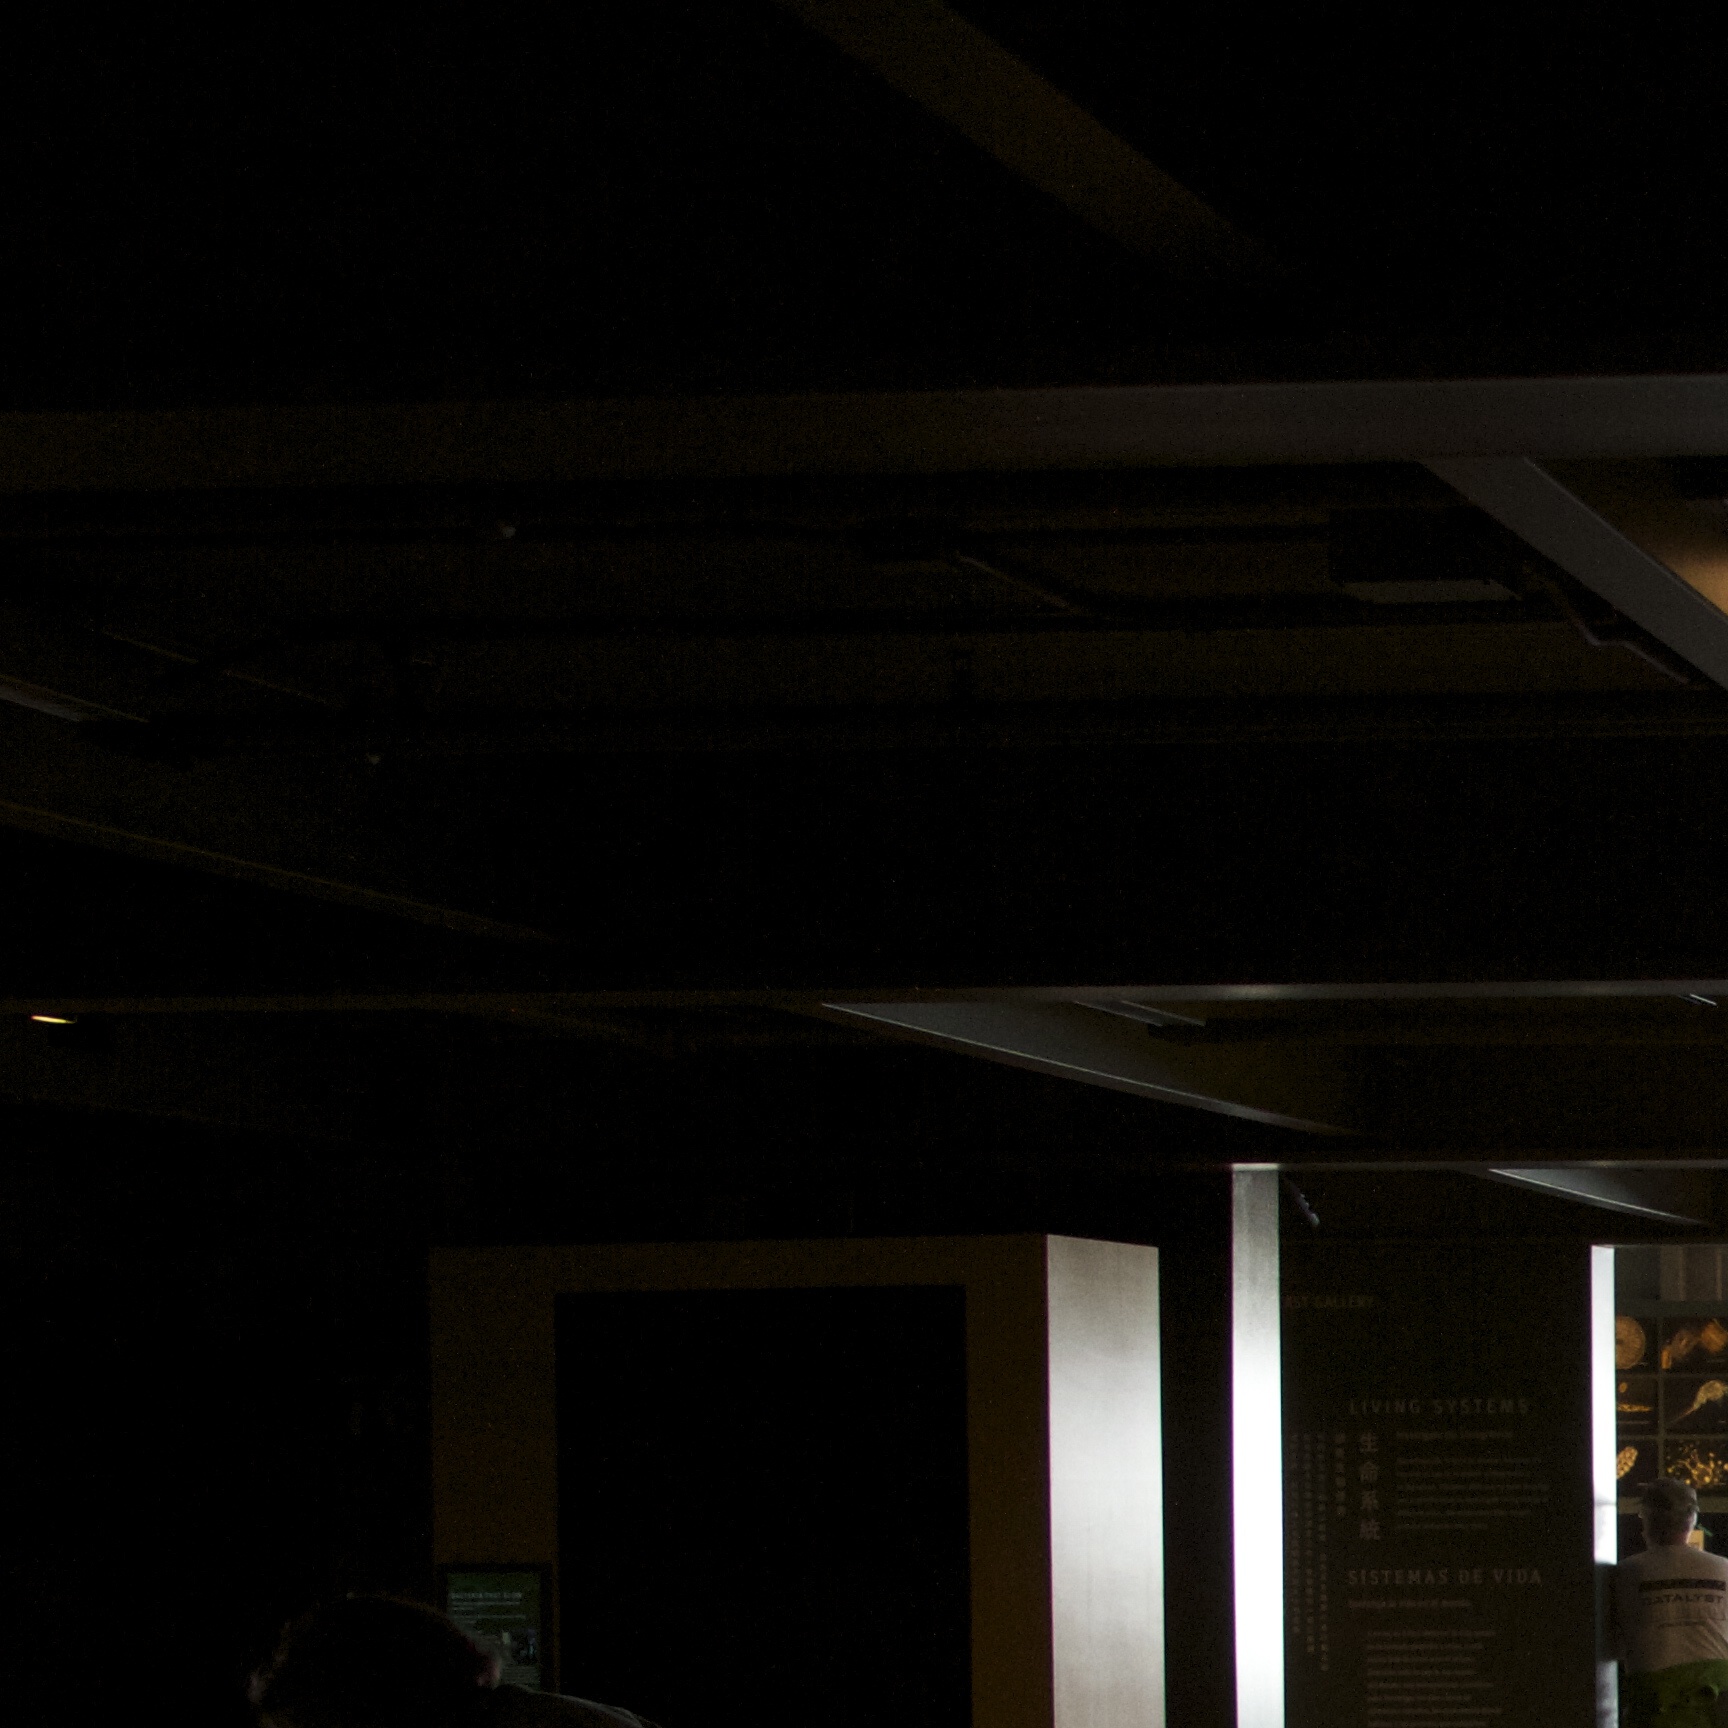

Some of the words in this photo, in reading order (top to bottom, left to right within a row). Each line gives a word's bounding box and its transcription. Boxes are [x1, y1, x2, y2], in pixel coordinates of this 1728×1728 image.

[1349, 1398, 1421, 1415] LIVING
[1433, 1398, 1529, 1415] SYSTEMS
[1347, 1568, 1448, 1586] SISTEMAS
[1458, 1568, 1483, 1585] DE
[1493, 1568, 1542, 1585] VIDA
